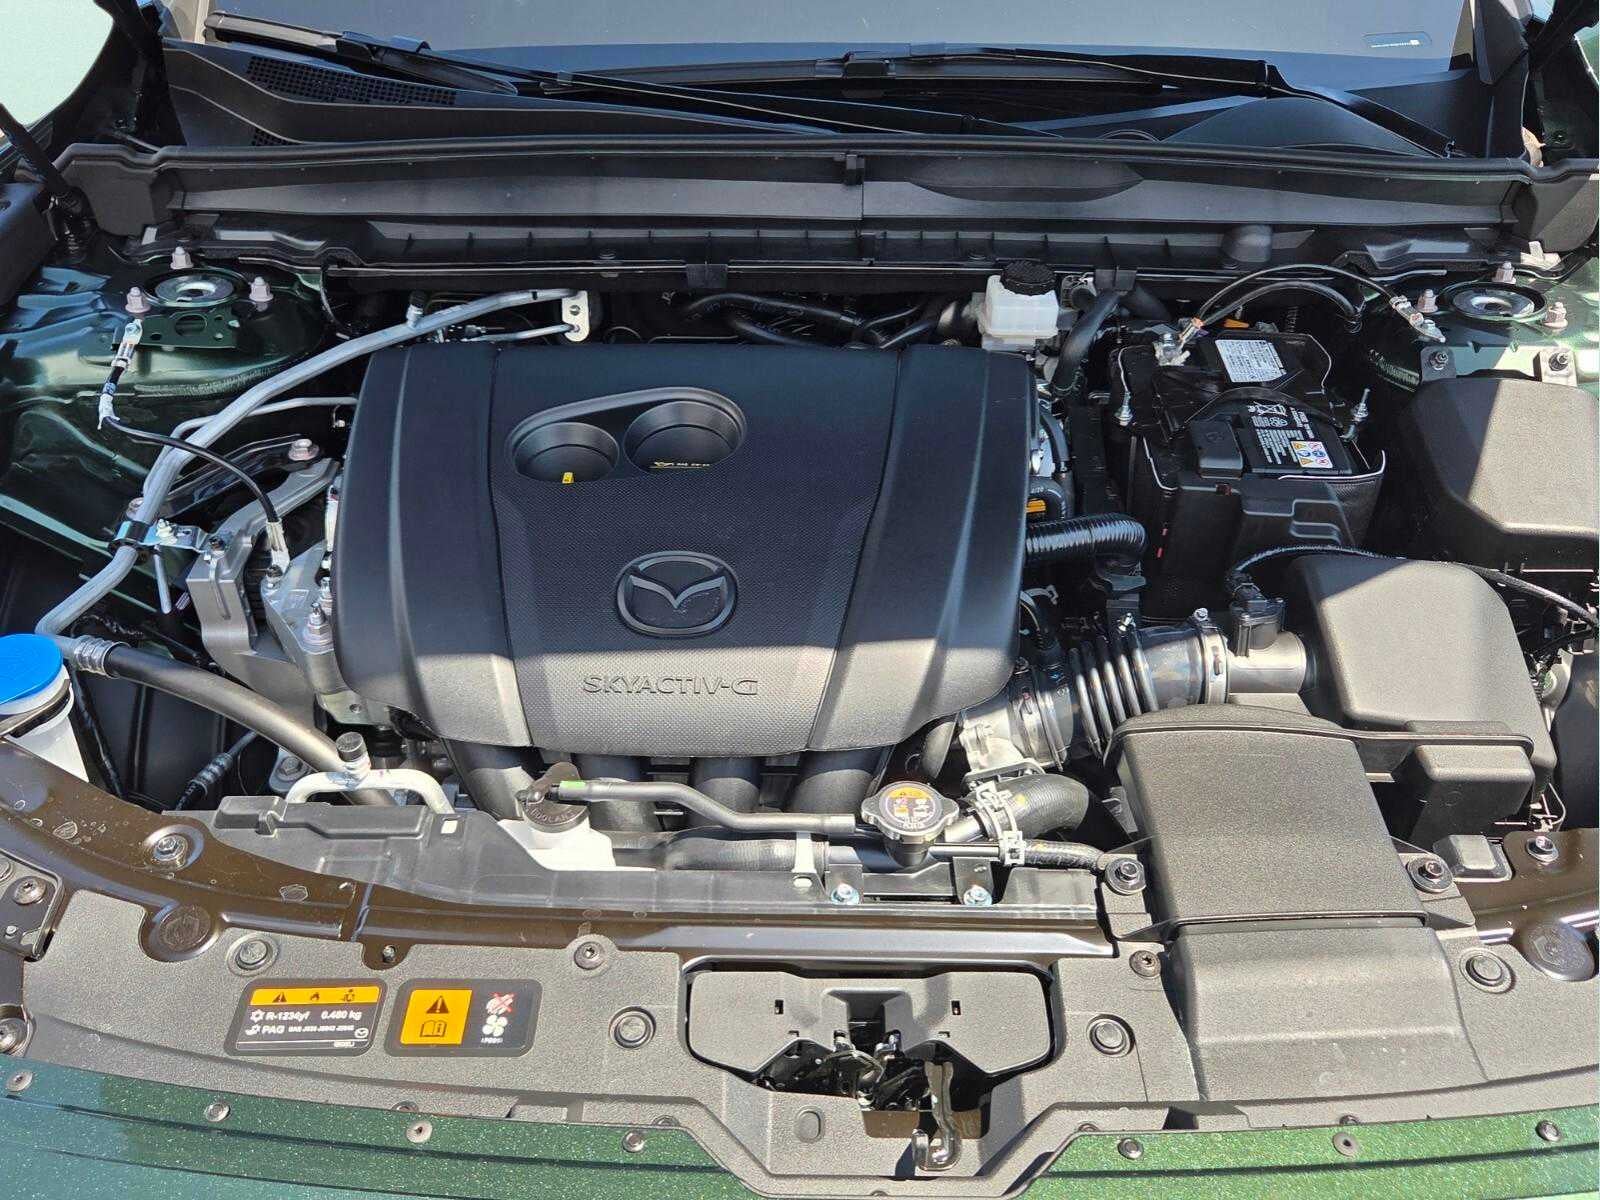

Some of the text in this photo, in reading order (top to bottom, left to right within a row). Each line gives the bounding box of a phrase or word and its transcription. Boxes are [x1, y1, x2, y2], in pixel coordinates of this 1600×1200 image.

[582, 675, 759, 696] SKYACTIV-G
[265, 1010, 310, 1022] R-1234yf
[349, 1010, 362, 1020] kg
[261, 1025, 285, 1034] PAG
